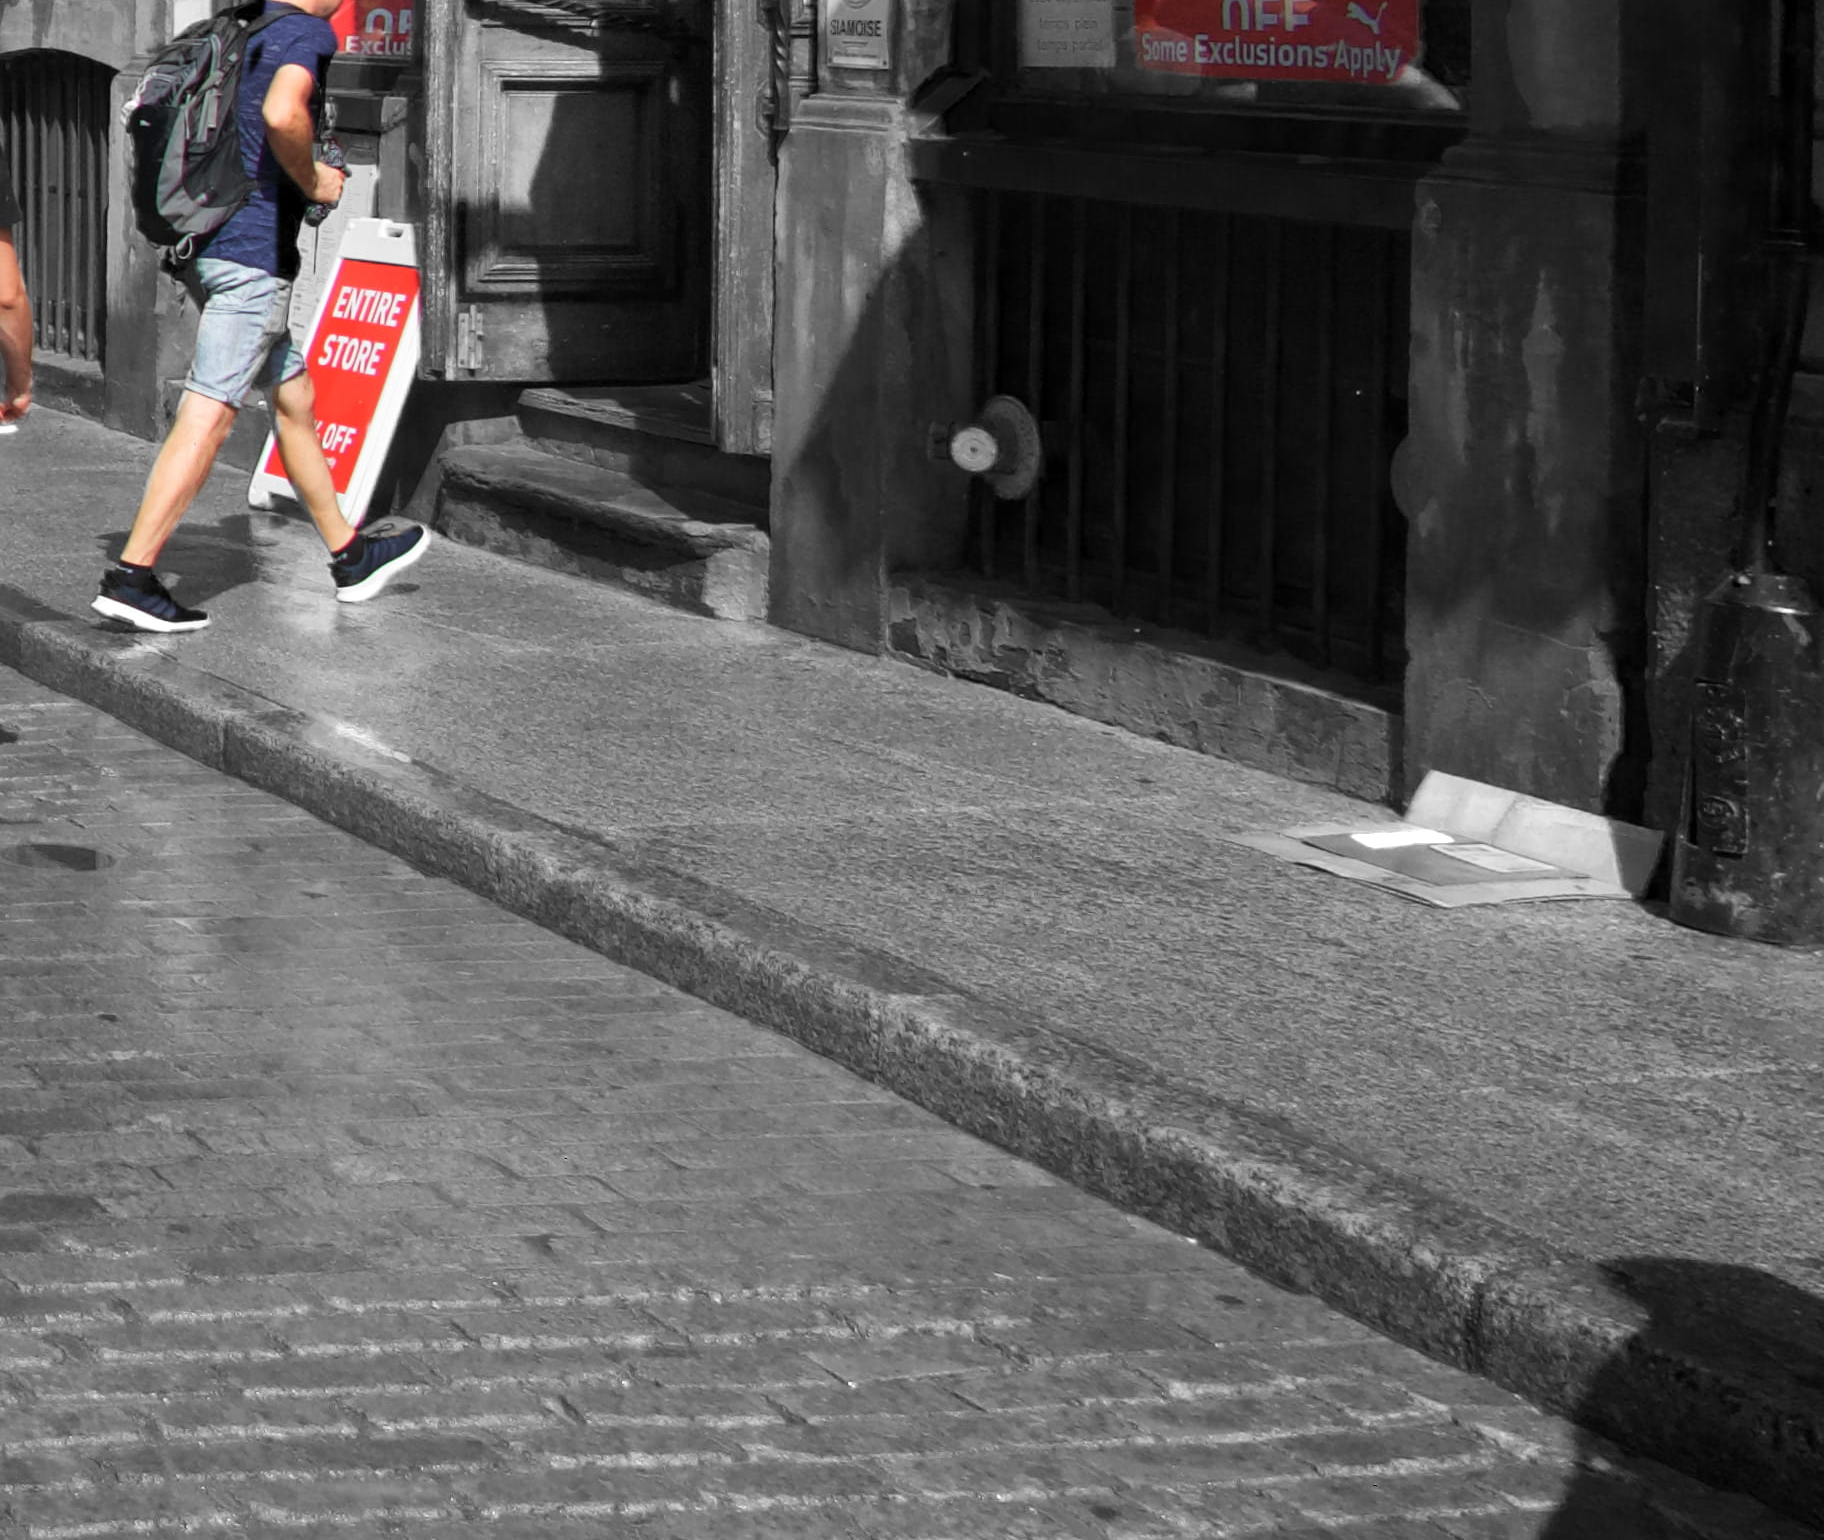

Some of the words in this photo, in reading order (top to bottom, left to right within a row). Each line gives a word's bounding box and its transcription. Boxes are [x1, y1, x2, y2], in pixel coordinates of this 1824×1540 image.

[830, 19, 882, 37] SIAMOISE
[1141, 33, 1187, 62] Some
[1193, 34, 1327, 68] Exclusions
[1333, 39, 1401, 79] Apply
[332, 285, 406, 328] ENTIRE
[318, 333, 385, 376] STORE
[322, 422, 357, 453] OFF
